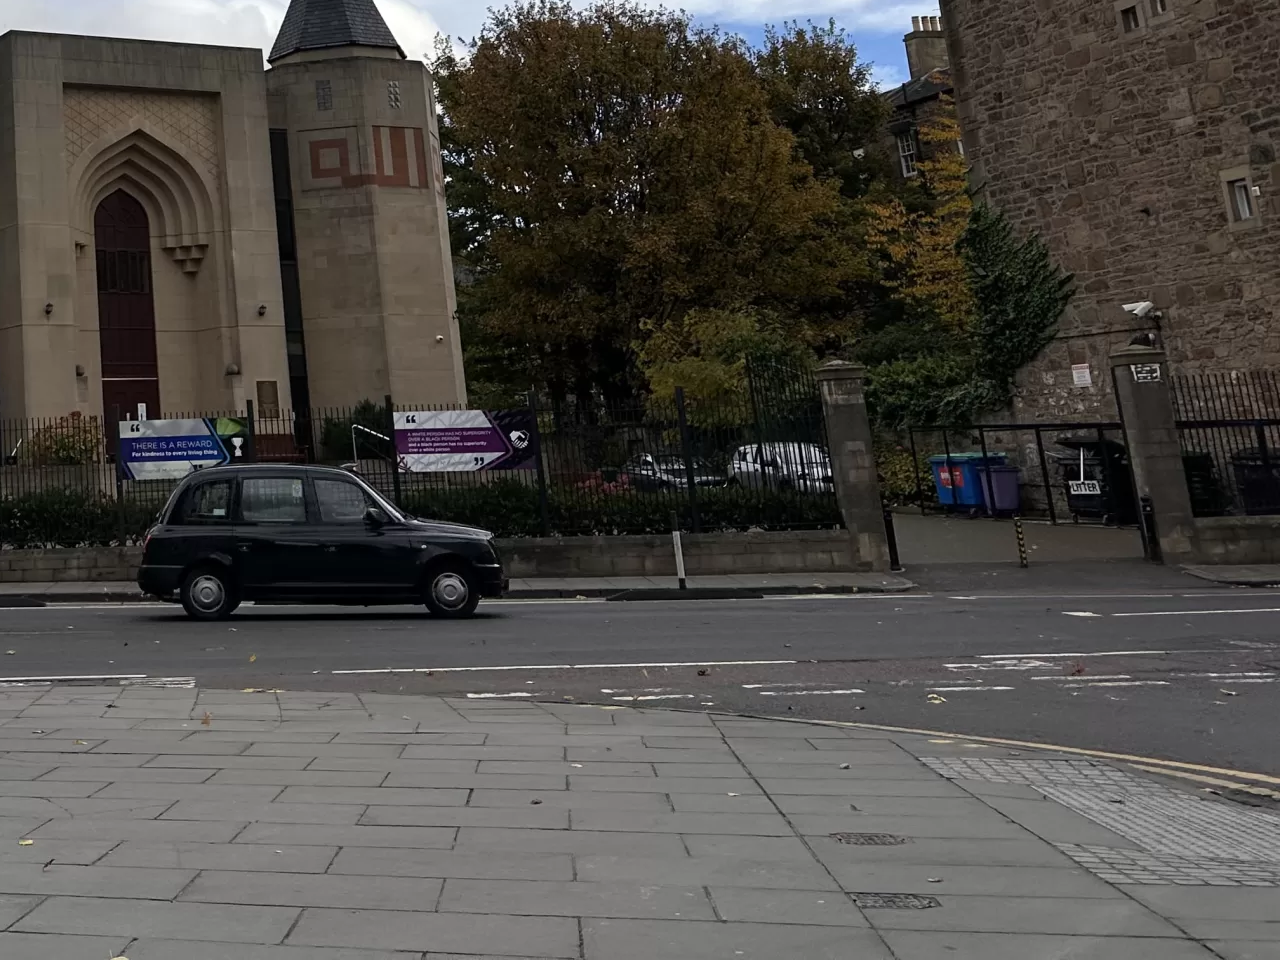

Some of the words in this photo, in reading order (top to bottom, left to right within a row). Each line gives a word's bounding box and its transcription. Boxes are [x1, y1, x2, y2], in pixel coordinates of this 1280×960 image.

[132, 442, 158, 450] THERE
[177, 440, 213, 448] REWARD
[1072, 482, 1098, 492] LITTER
